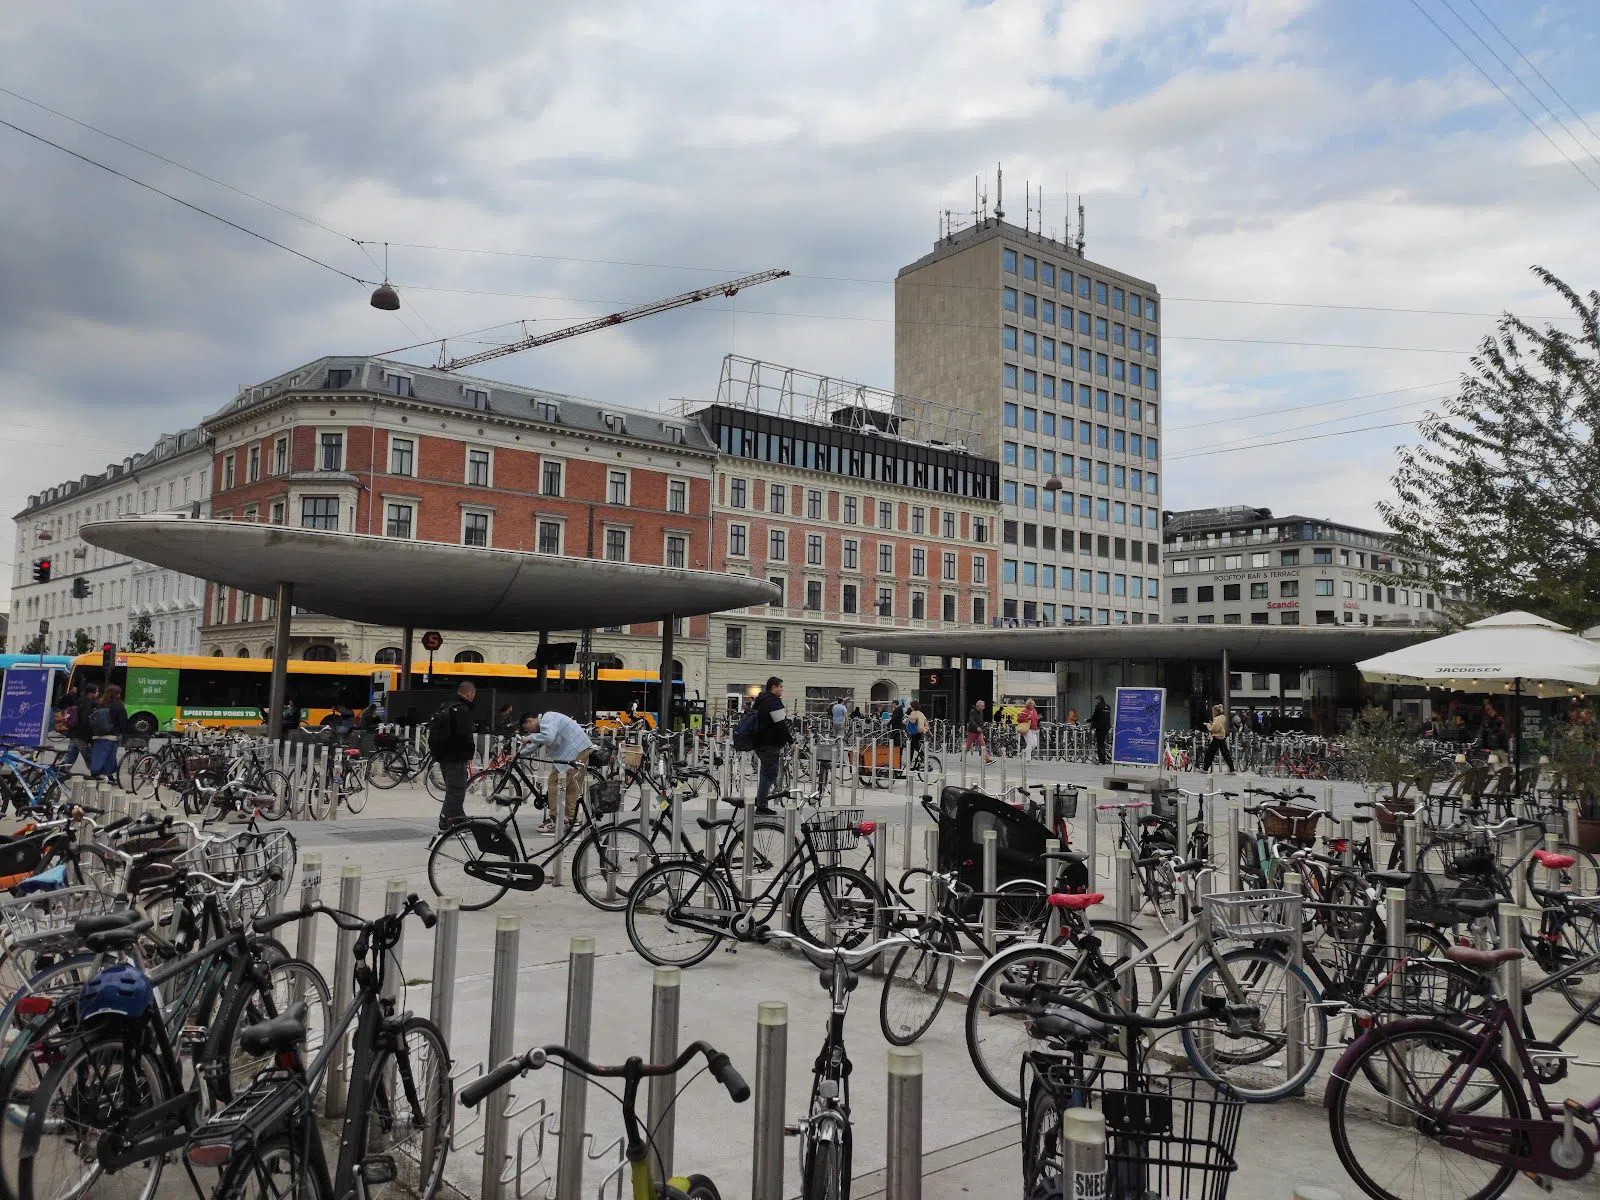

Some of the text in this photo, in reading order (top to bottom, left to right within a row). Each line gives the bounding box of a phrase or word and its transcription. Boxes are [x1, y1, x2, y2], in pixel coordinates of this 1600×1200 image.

[1213, 573, 1246, 582] ROOFTOP
[1247, 572, 1261, 580] BAR
[1270, 570, 1300, 579] TERRACE
[1267, 600, 1300, 609] Scandic
[930, 674, 937, 684] S
